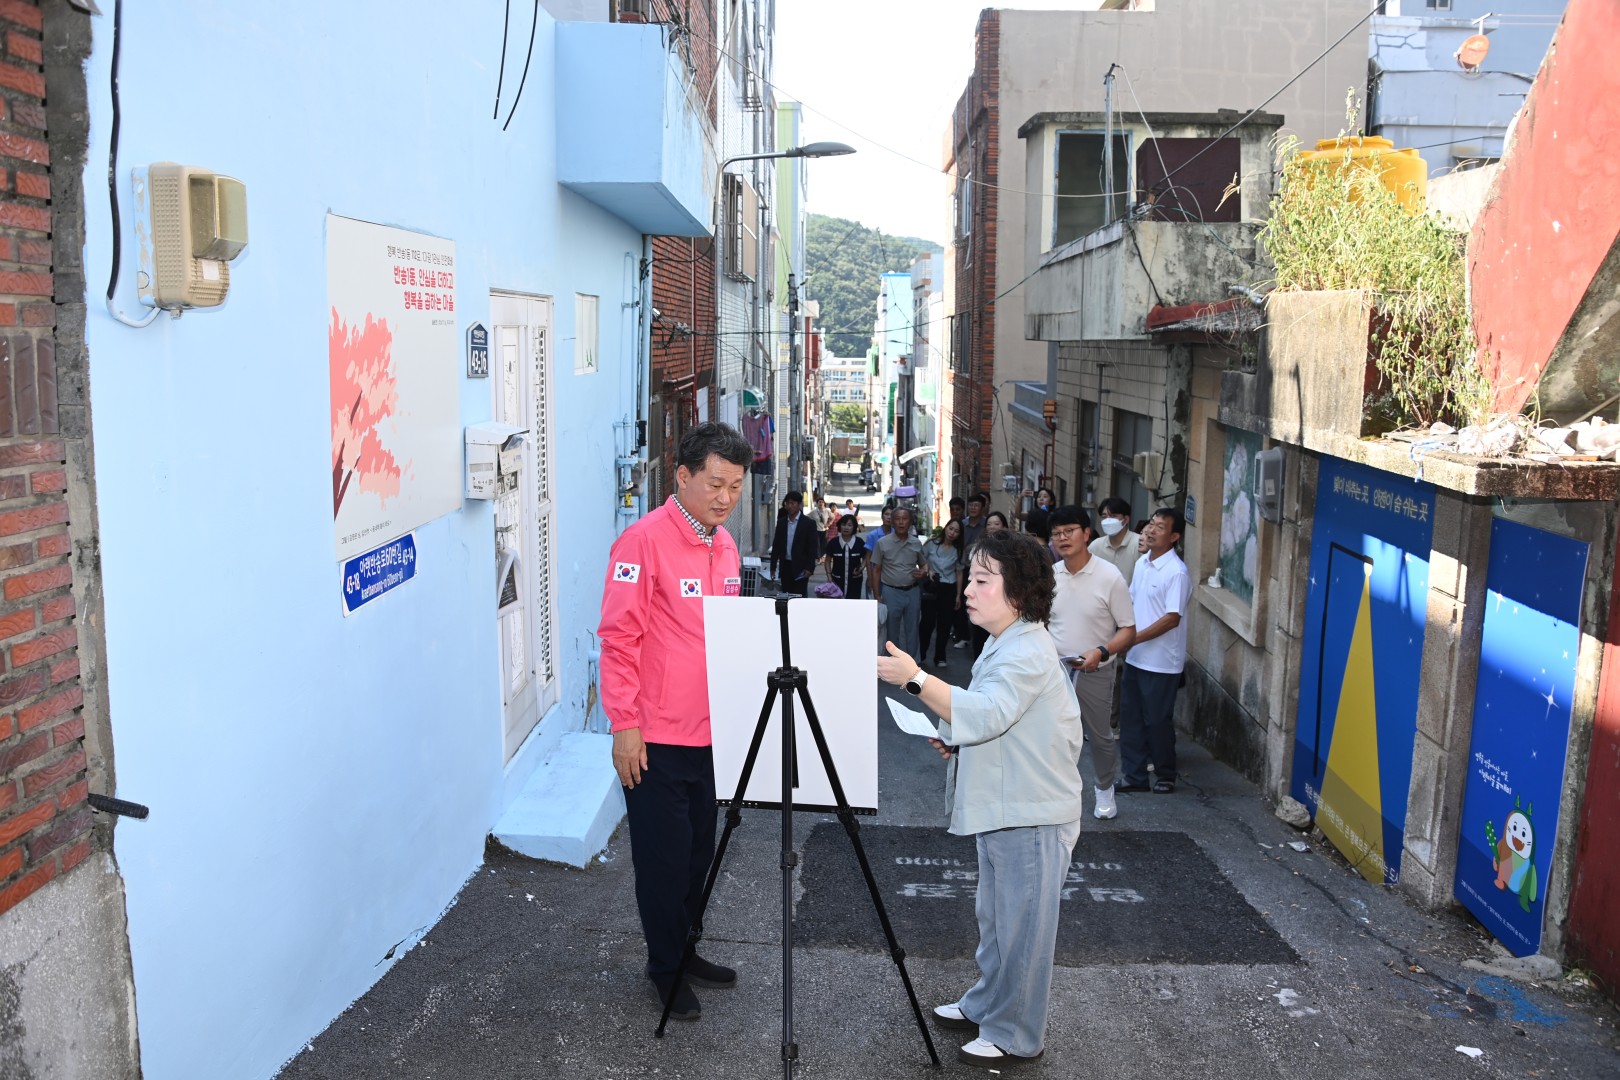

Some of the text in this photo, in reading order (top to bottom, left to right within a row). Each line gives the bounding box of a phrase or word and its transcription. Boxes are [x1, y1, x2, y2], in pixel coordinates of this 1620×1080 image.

[393, 265, 454, 289] 반송1동, 안심을 더하고
[404, 290, 454, 311] 행복을 곱하는 마을
[471, 350, 487, 371] 43-16
[1333, 476, 1345, 495] 빛이
[1361, 485, 1369, 504] 곳
[1373, 488, 1394, 511] 안전이
[1394, 494, 1402, 513] 숨
[1403, 497, 1418, 519] 쉬는
[1419, 502, 1428, 522] 곳
[346, 541, 414, 595] 43-18 아랫반송로60번길 43-14
